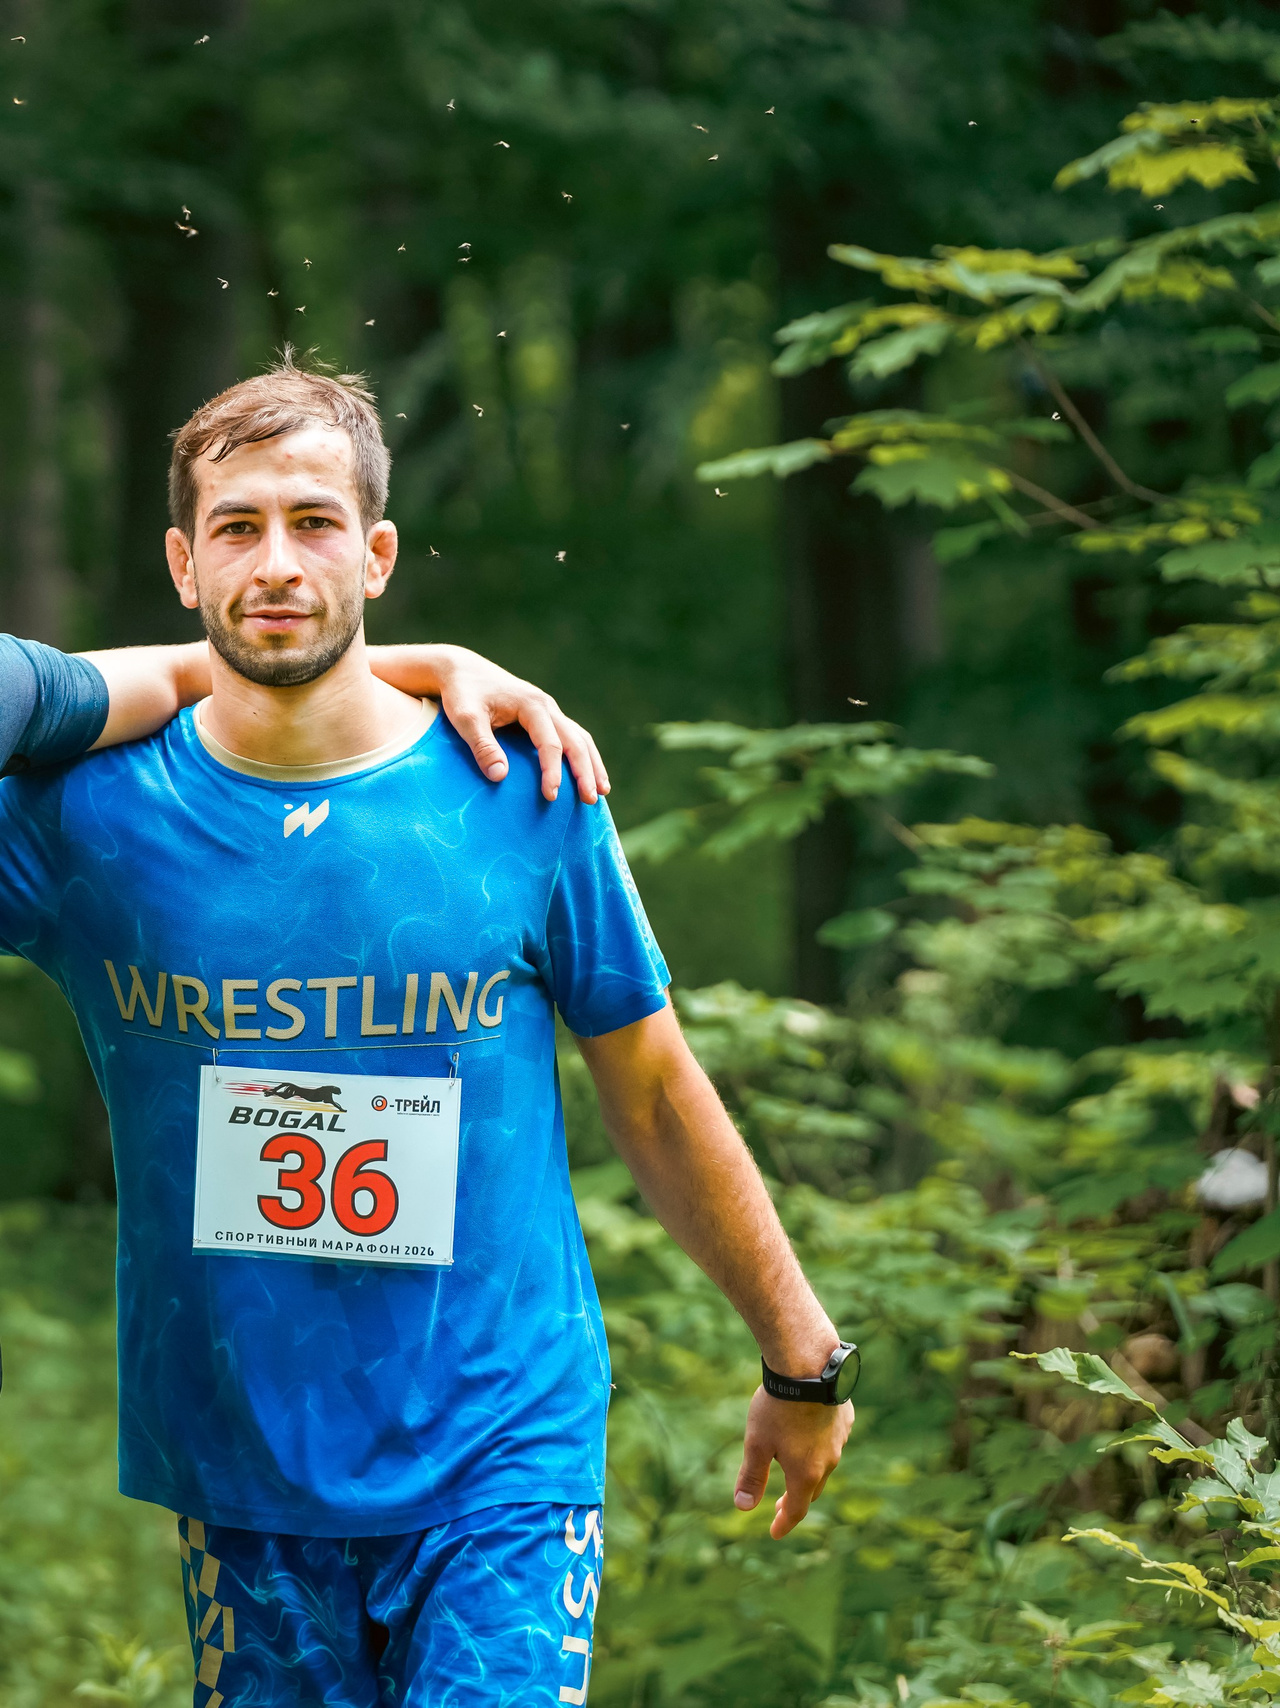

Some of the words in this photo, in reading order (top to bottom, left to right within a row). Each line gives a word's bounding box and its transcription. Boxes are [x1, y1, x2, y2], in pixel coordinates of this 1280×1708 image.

[103, 958, 511, 1040] WRESTLING
[228, 1105, 346, 1133] BOGAL
[257, 1132, 399, 1237] 36
[214, 1230, 318, 1248] СПОРТИВНЫЙ
[322, 1239, 400, 1255] МАРАФОН
[404, 1245, 435, 1257] 2026
